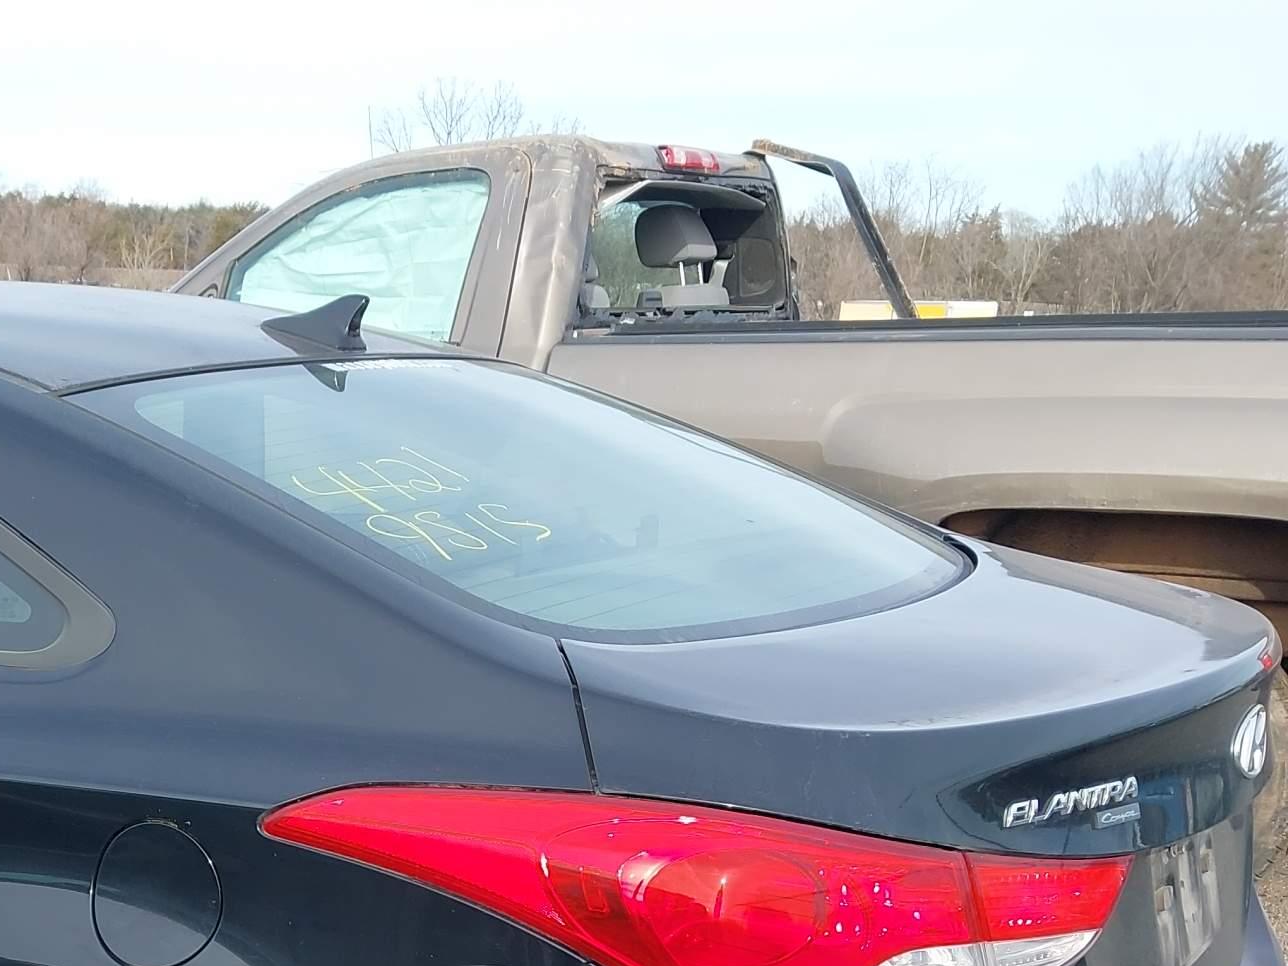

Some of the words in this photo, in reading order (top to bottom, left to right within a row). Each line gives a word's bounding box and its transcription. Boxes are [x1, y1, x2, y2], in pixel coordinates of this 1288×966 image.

[291, 446, 470, 512] 4421
[366, 503, 552, 561] 9515
[1003, 776, 1138, 828] ELANTRA
